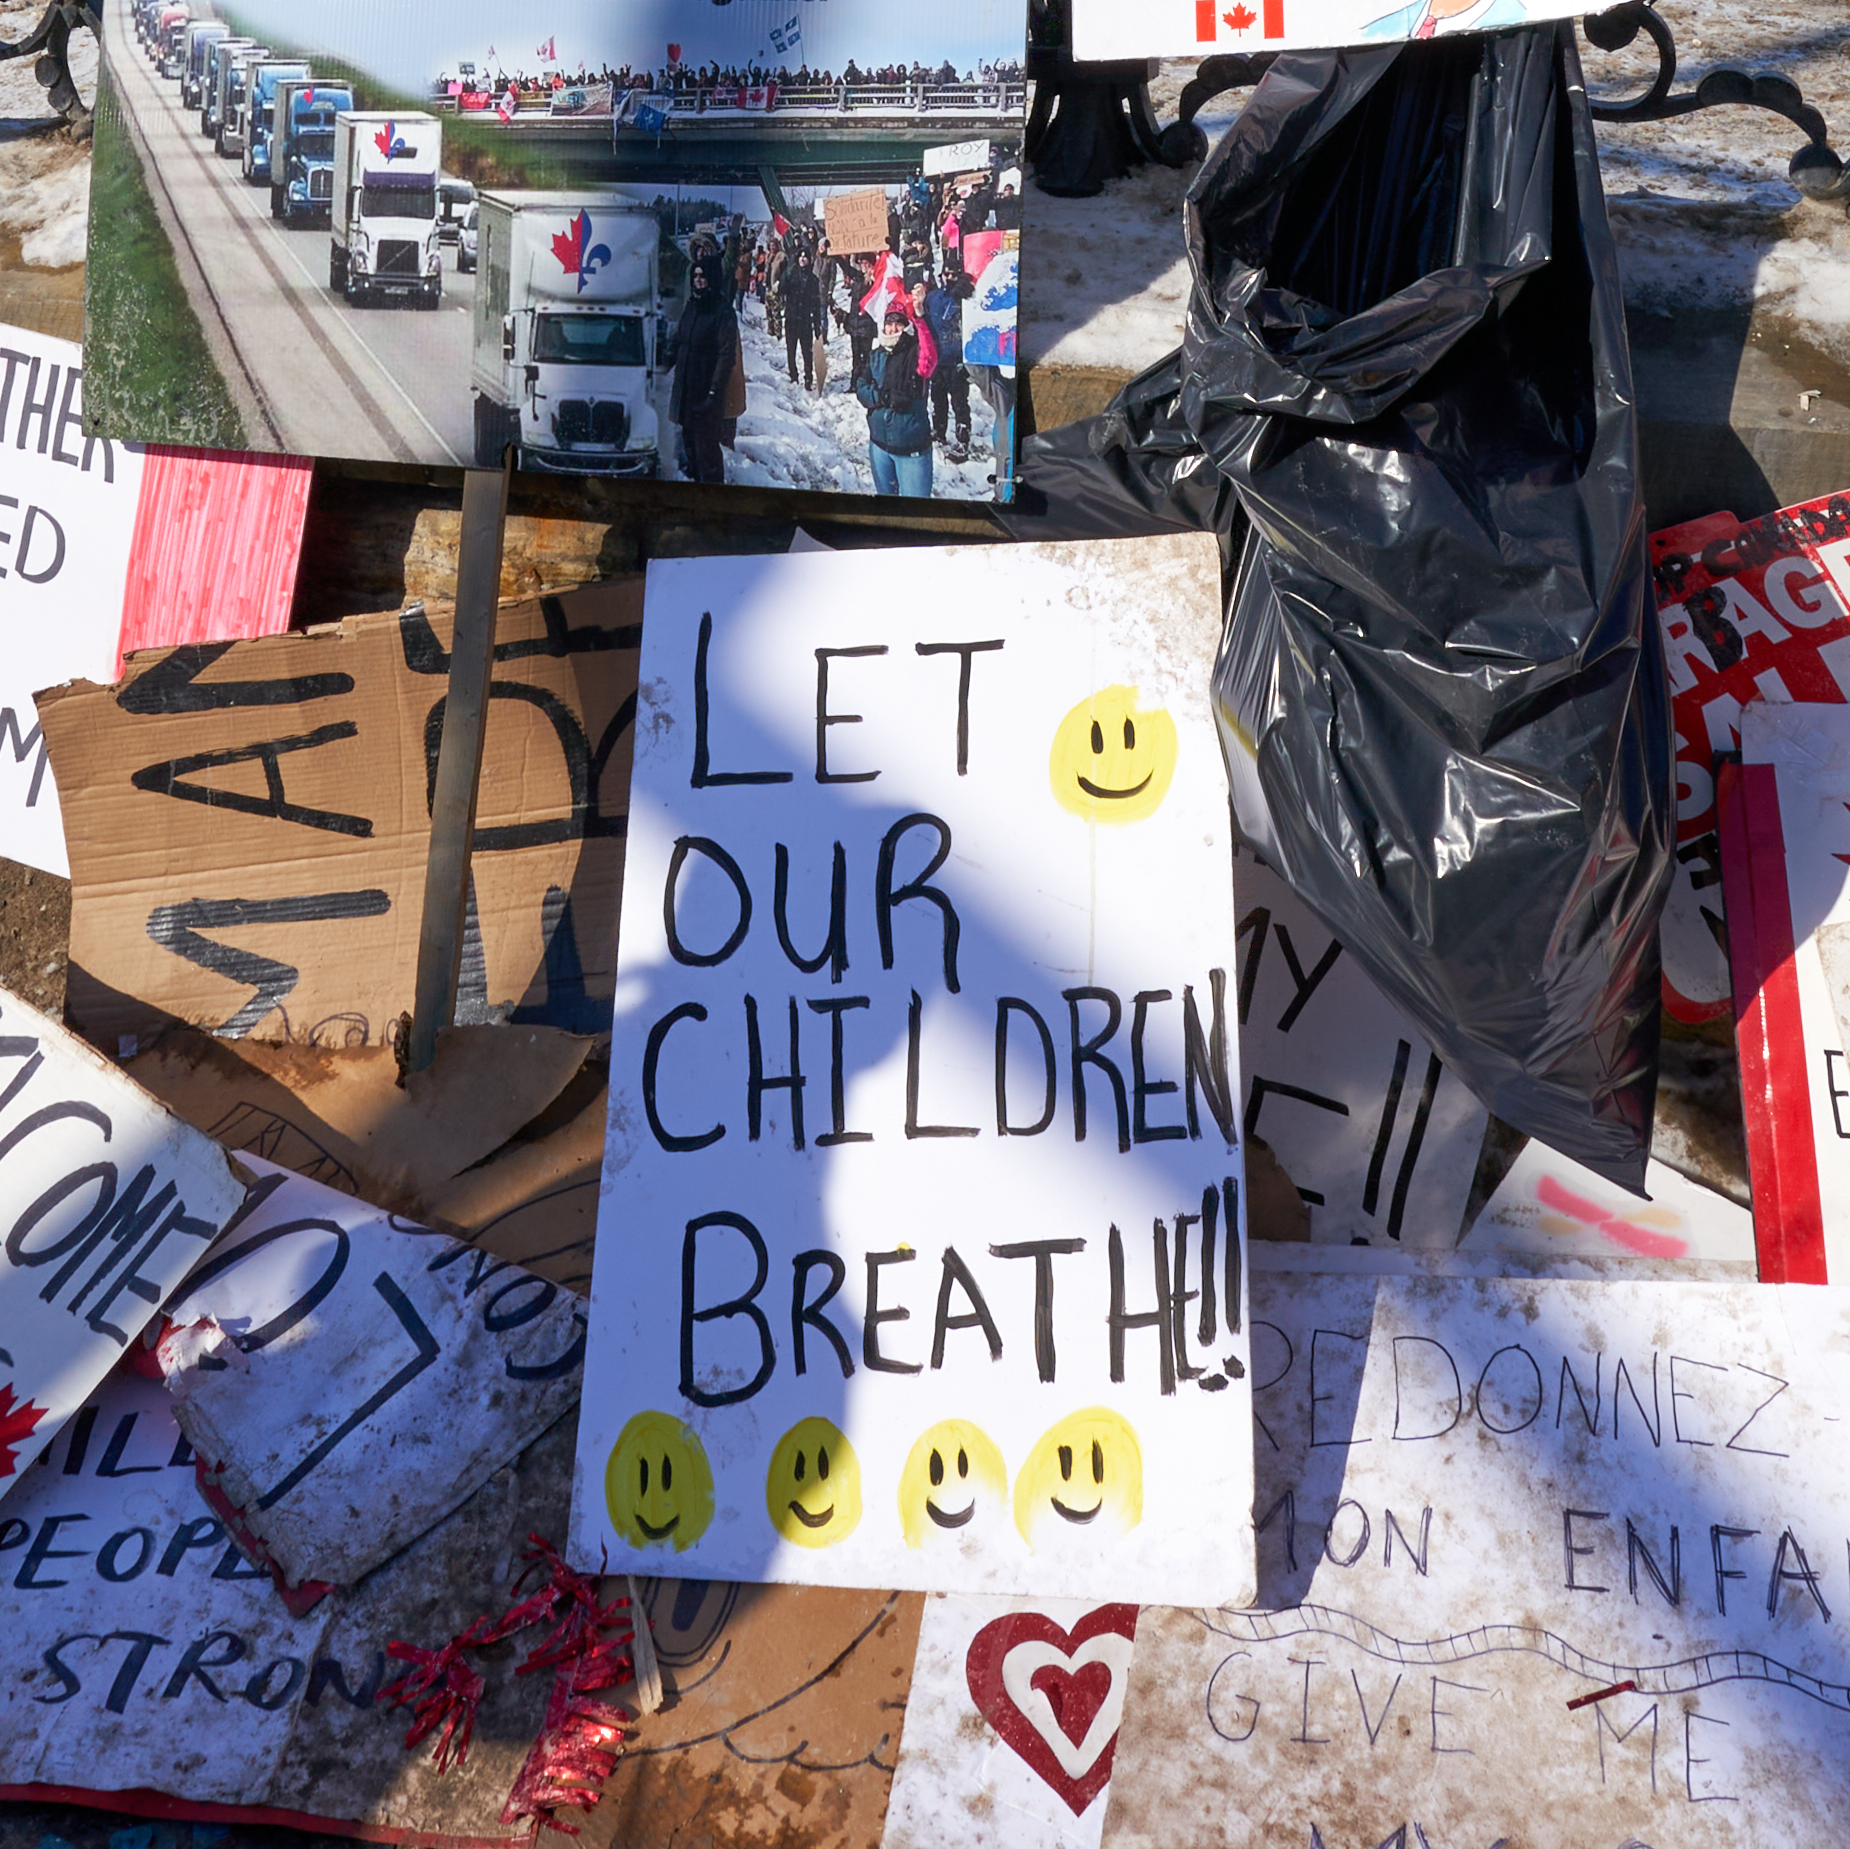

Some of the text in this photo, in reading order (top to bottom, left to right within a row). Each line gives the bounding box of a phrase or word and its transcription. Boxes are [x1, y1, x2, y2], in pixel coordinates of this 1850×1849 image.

[691, 611, 1005, 790] LET
[664, 812, 961, 994] OUR
[642, 967, 1239, 1154] CHILDREN
[1206, 1650, 1489, 1752] GIVE
[1597, 1702, 1739, 1804] ME
